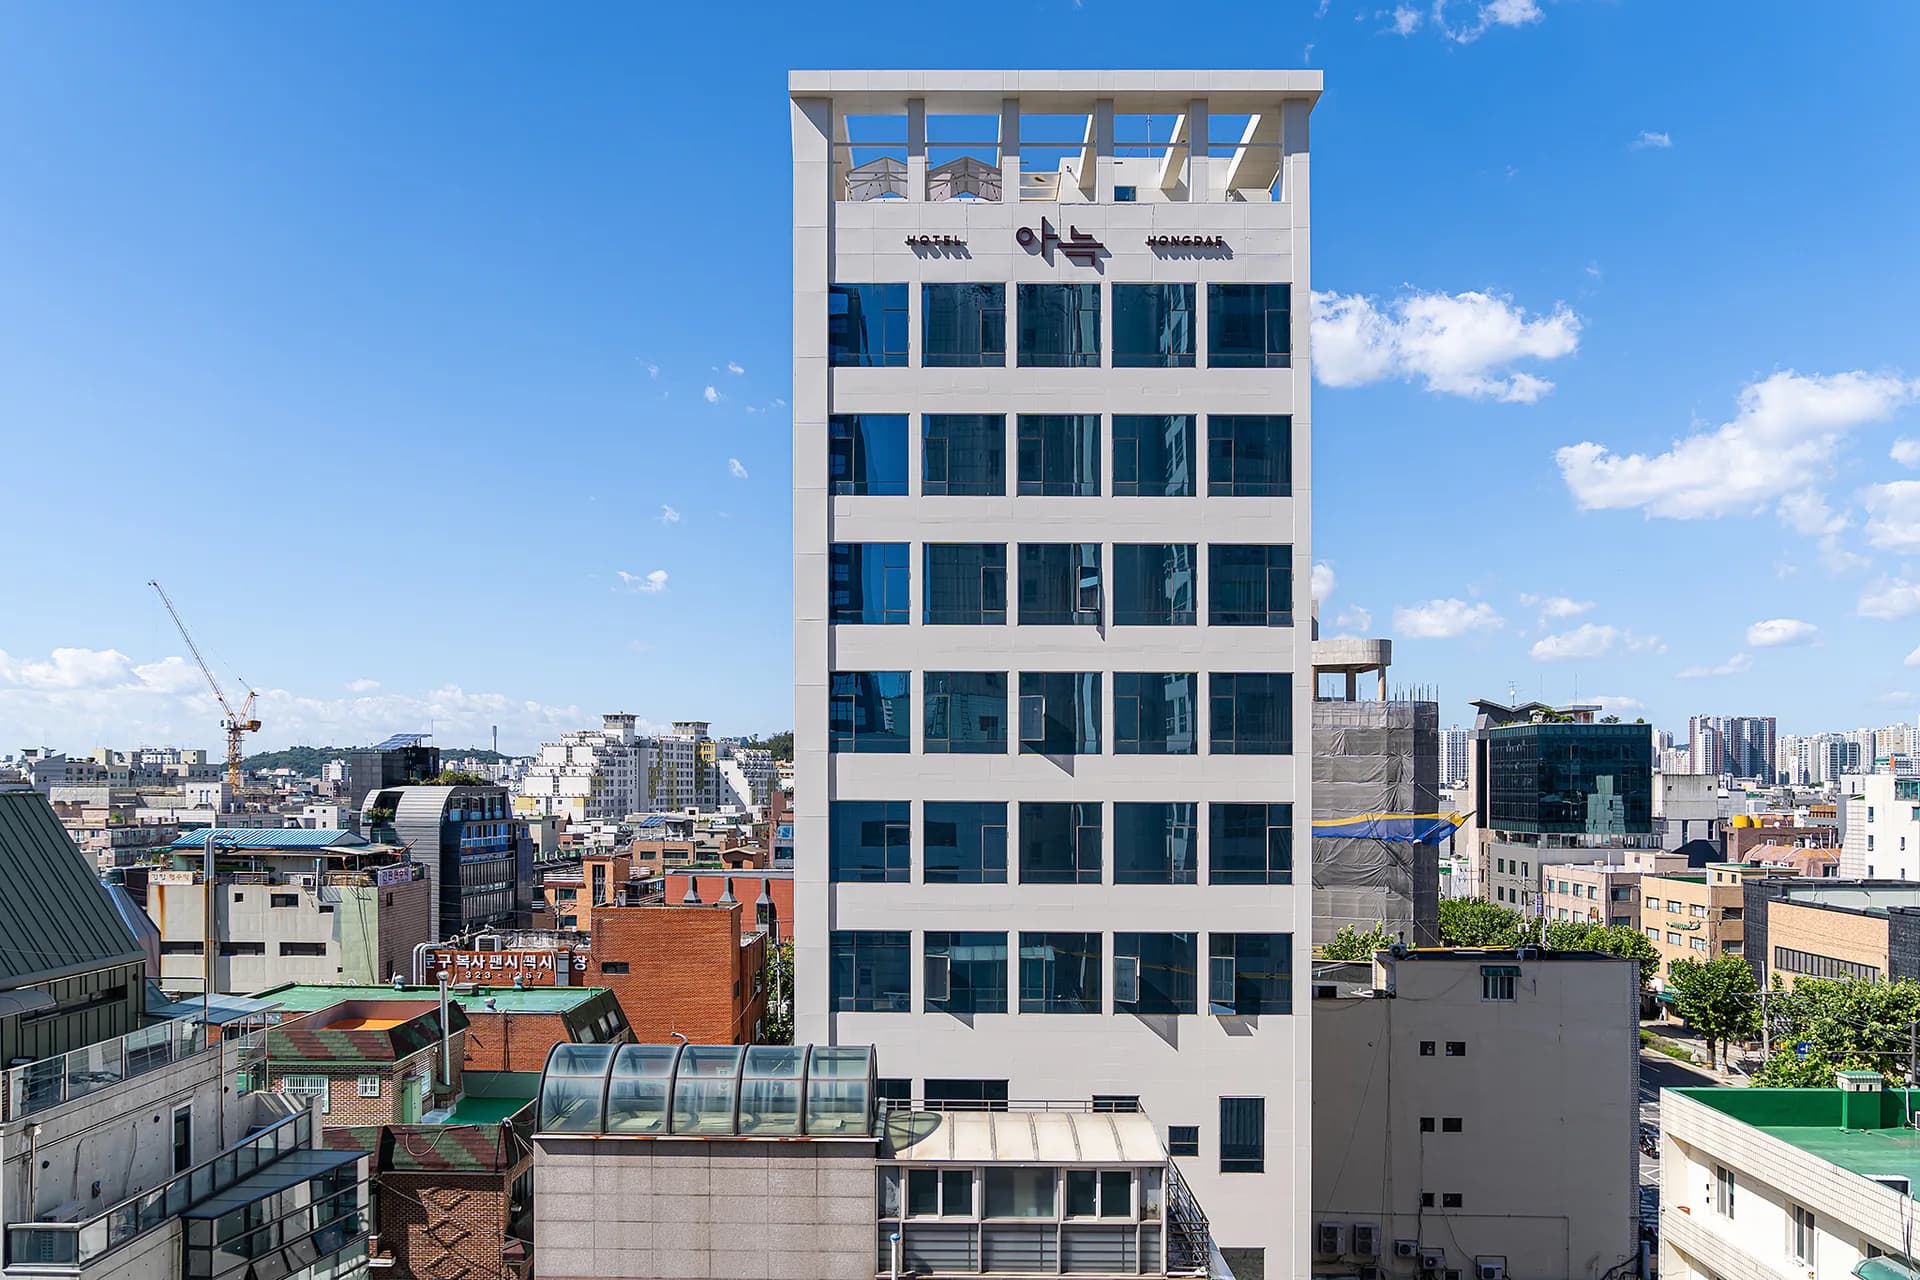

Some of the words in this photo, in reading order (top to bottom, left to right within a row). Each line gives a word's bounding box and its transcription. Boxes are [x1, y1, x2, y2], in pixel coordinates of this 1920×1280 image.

[907, 235, 961, 246] HOTEL
[1016, 216, 1104, 266] 아늑
[1147, 235, 1223, 246] HONGDAE
[456, 954, 486, 969] 복사
[489, 954, 518, 970] 팬시
